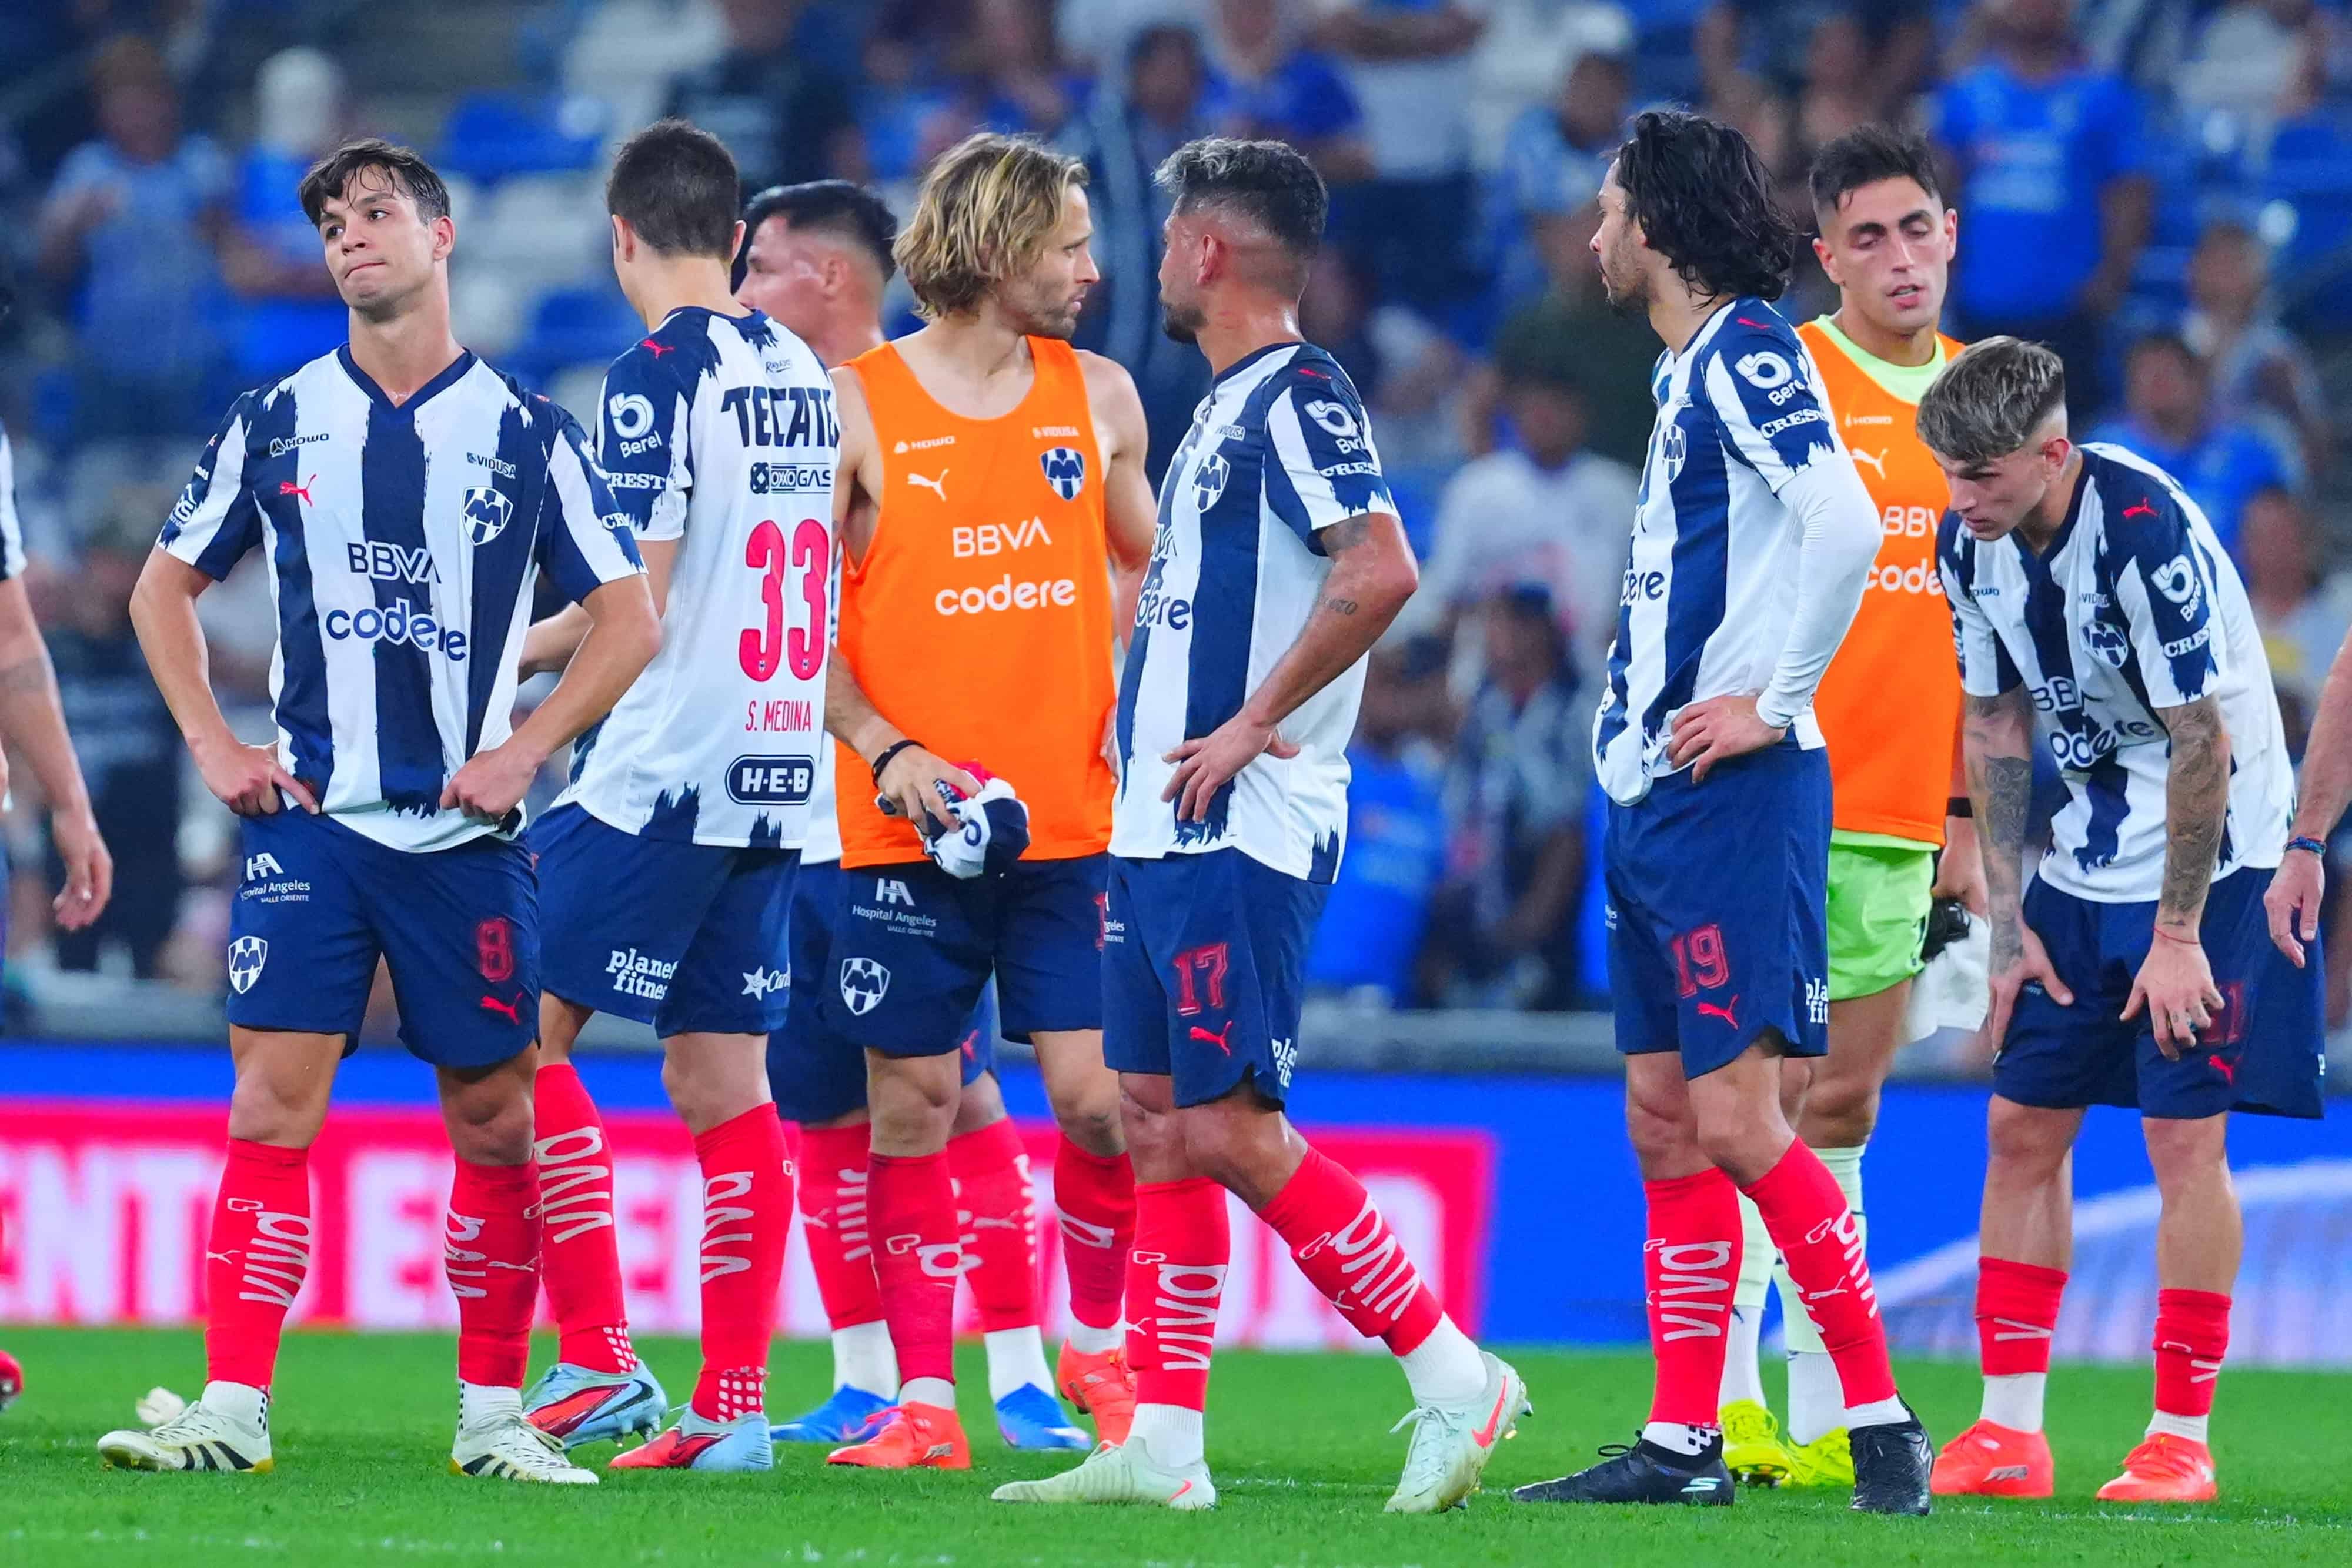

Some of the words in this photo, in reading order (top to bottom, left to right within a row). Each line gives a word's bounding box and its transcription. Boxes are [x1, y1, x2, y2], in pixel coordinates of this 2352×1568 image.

[286, 433, 329, 449] HOWO
[619, 430, 663, 458] Berel
[911, 436, 956, 449] HOWO
[476, 455, 516, 479] VIDUSA
[609, 472, 666, 489] REST
[952, 516, 1052, 557] BBVA
[739, 519, 830, 682] 33
[935, 574, 1076, 615] codere
[1136, 578, 1191, 630] dere
[746, 700, 758, 731] S.
[763, 700, 811, 731] MEDINA
[268, 879, 311, 894] Angeles
[852, 904, 893, 921] Hospital
[895, 912, 937, 927] Angeles
[476, 918, 515, 984] 8
[1670, 922, 1729, 999] 19
[1174, 941, 1229, 1017] 17
